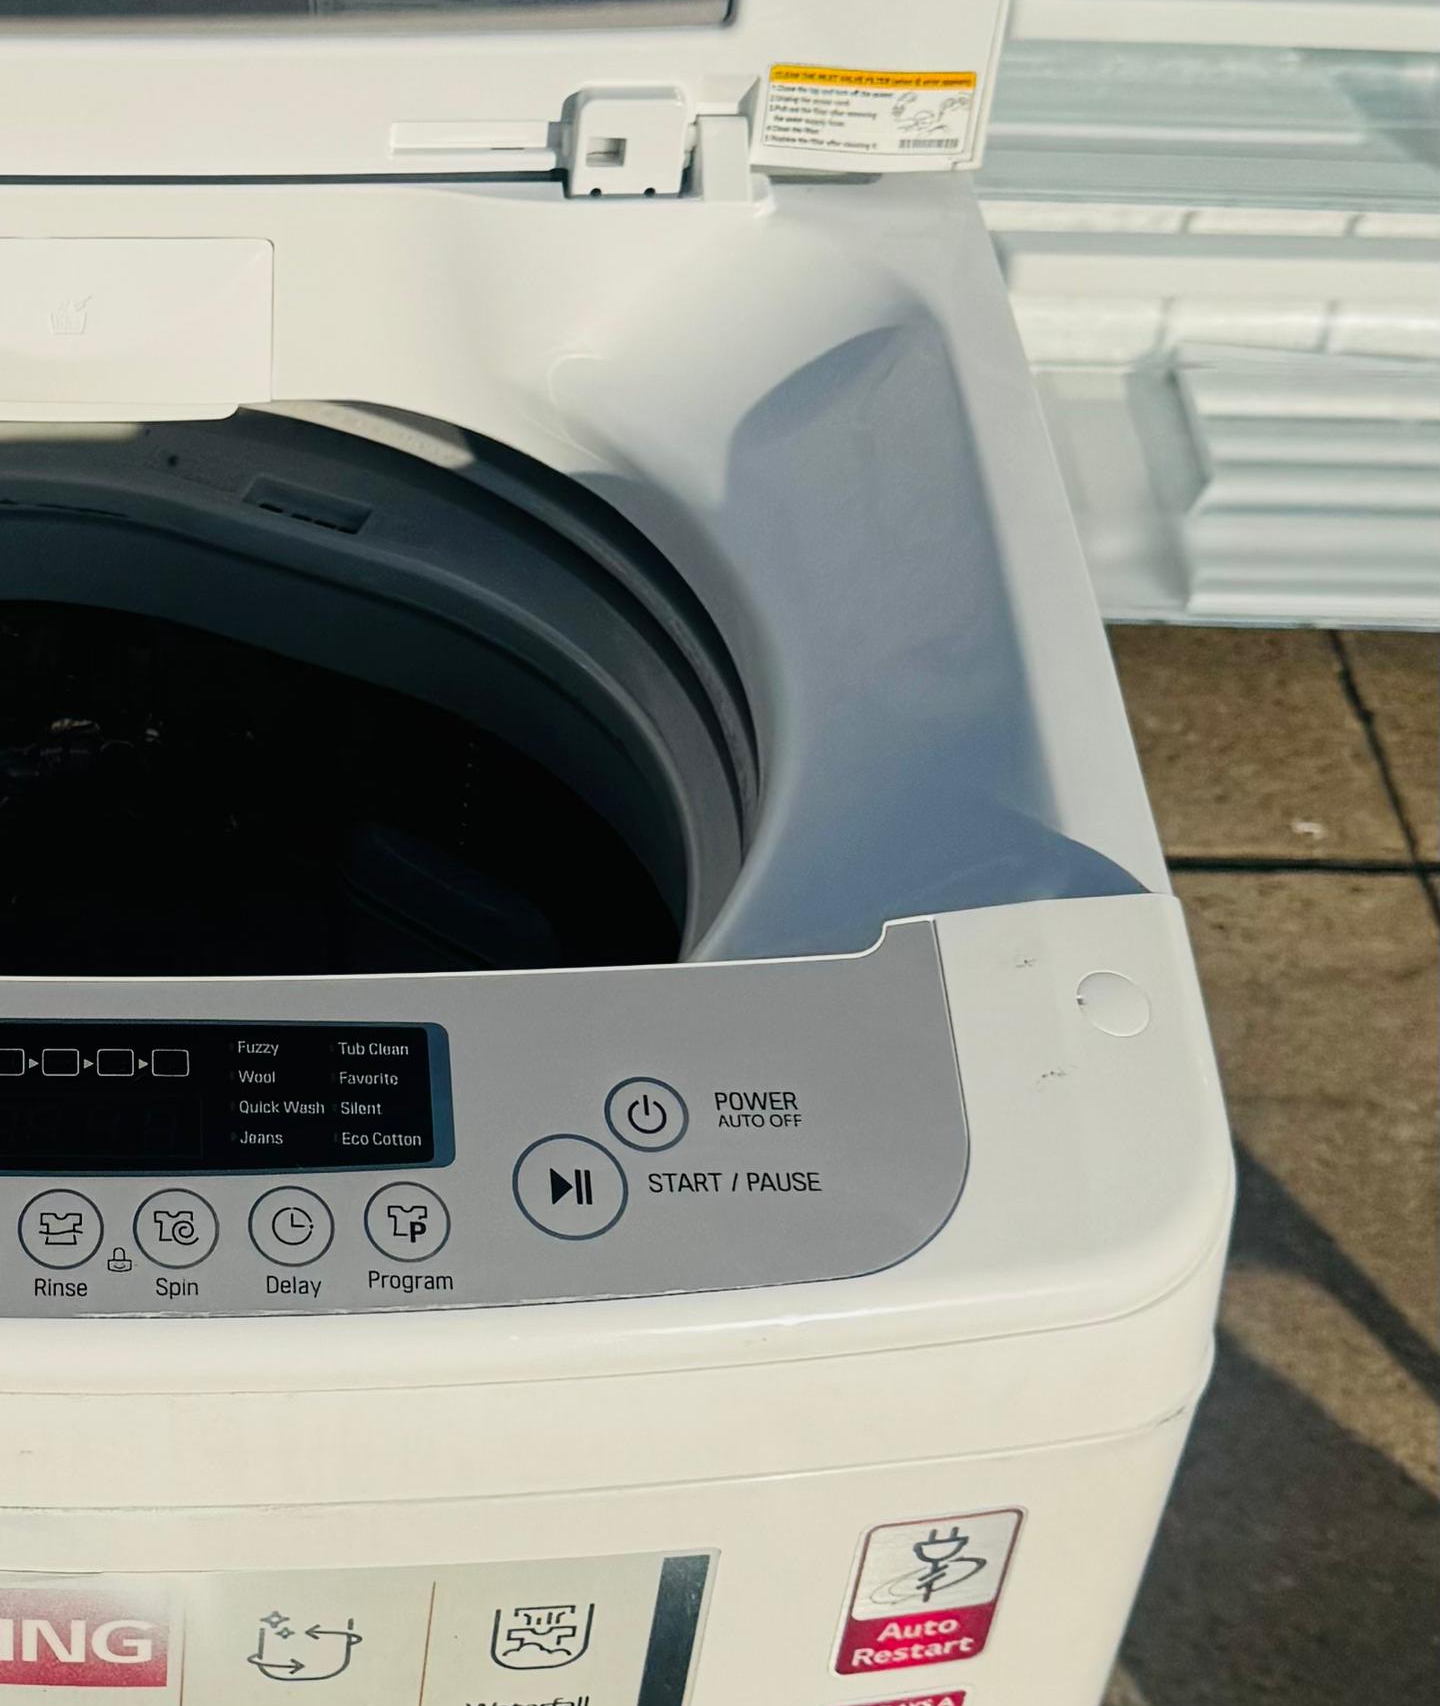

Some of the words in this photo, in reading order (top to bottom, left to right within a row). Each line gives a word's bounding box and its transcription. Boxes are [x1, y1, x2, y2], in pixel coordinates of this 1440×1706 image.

[237, 1040, 279, 1058] Fuzzy
[338, 1041, 364, 1056] Tub
[368, 1042, 409, 1057] Clean
[238, 1069, 276, 1085] Wool
[339, 1070, 398, 1086] Favorite
[239, 1100, 280, 1115] Quick
[283, 1100, 325, 1115] Wash
[340, 1101, 382, 1116] Silent
[714, 1091, 798, 1111] POWER
[718, 1114, 765, 1128] AUTO
[770, 1114, 803, 1128] OFF
[239, 1130, 283, 1146] Jeans
[341, 1131, 368, 1147] Eco
[371, 1131, 422, 1147] Cotton
[648, 1172, 722, 1193] START
[747, 1171, 822, 1192] PAUSE
[34, 1277, 88, 1297] Rinse
[155, 1277, 199, 1299] Spin
[266, 1274, 322, 1298] Delay
[368, 1270, 454, 1295] Program
[876, 1617, 959, 1642] Auto
[851, 1636, 975, 1667] Restart
